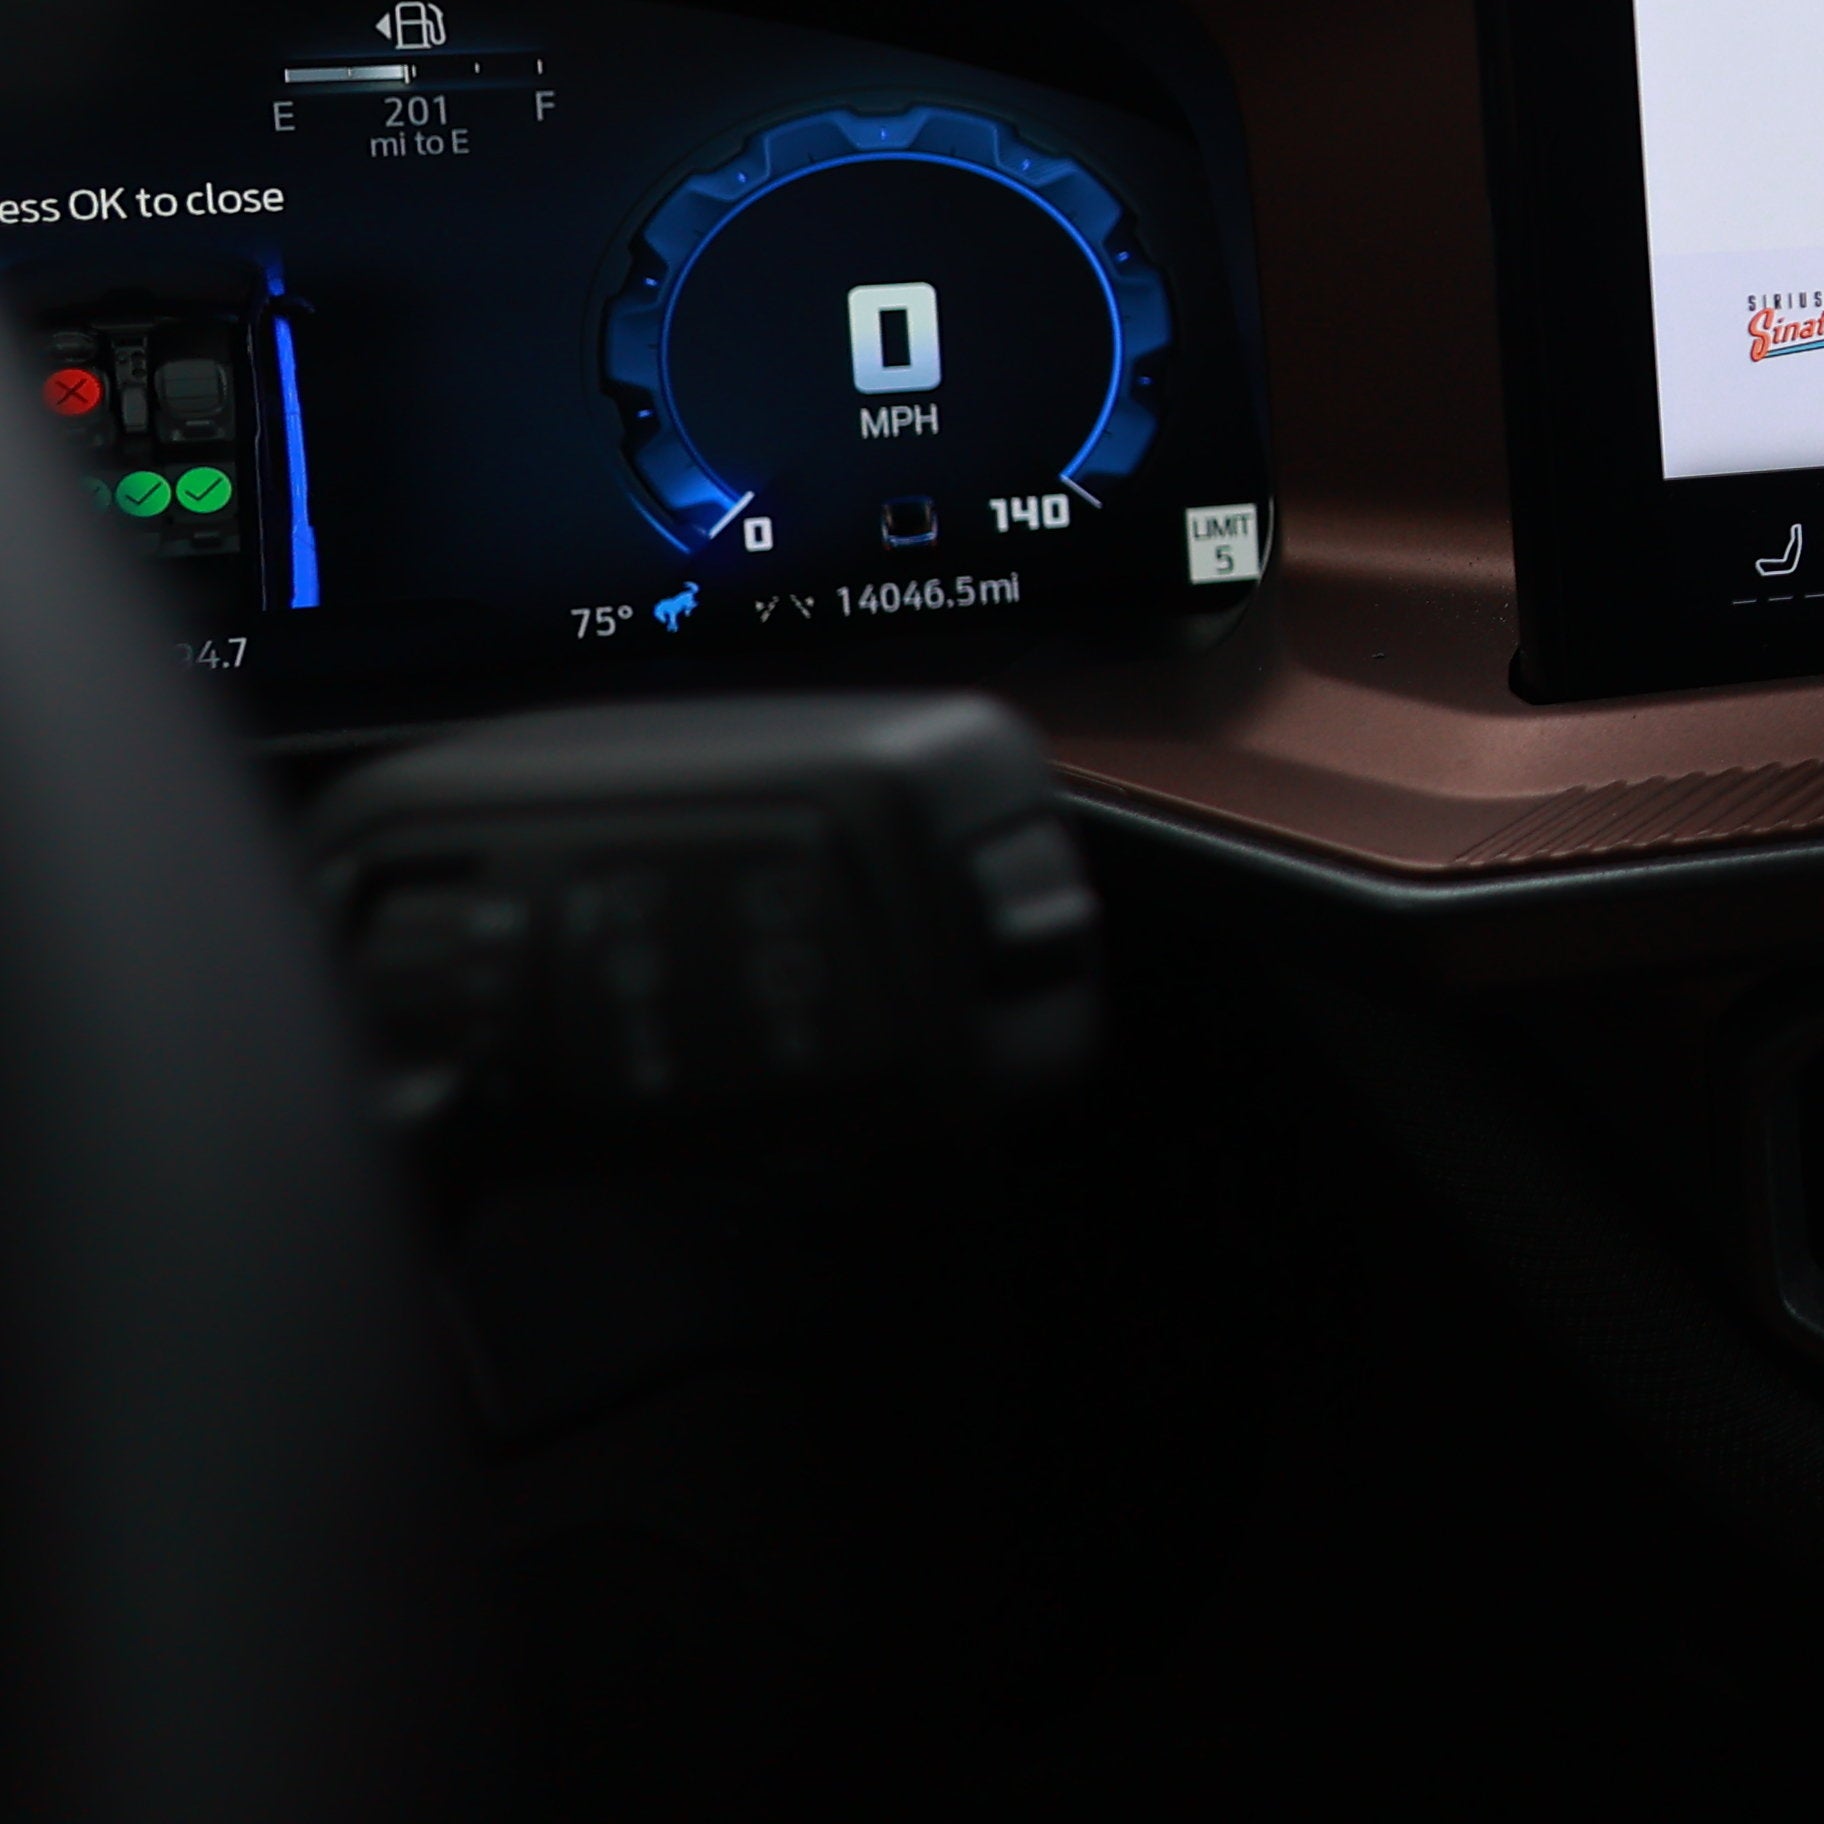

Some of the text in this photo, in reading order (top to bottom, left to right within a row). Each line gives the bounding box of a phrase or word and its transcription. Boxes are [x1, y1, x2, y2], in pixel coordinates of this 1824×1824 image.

[273, 101, 296, 132] E
[384, 95, 447, 127] 201
[535, 90, 555, 121] F
[370, 129, 470, 158] mi to E
[68, 187, 128, 221] OK
[135, 188, 178, 218] to
[186, 182, 284, 216] close
[847, 281, 941, 394] 0
[860, 403, 939, 439] MPH
[988, 493, 1071, 534] 140
[743, 516, 773, 552] 0
[1215, 544, 1235, 576] 5
[570, 605, 634, 639] 75°
